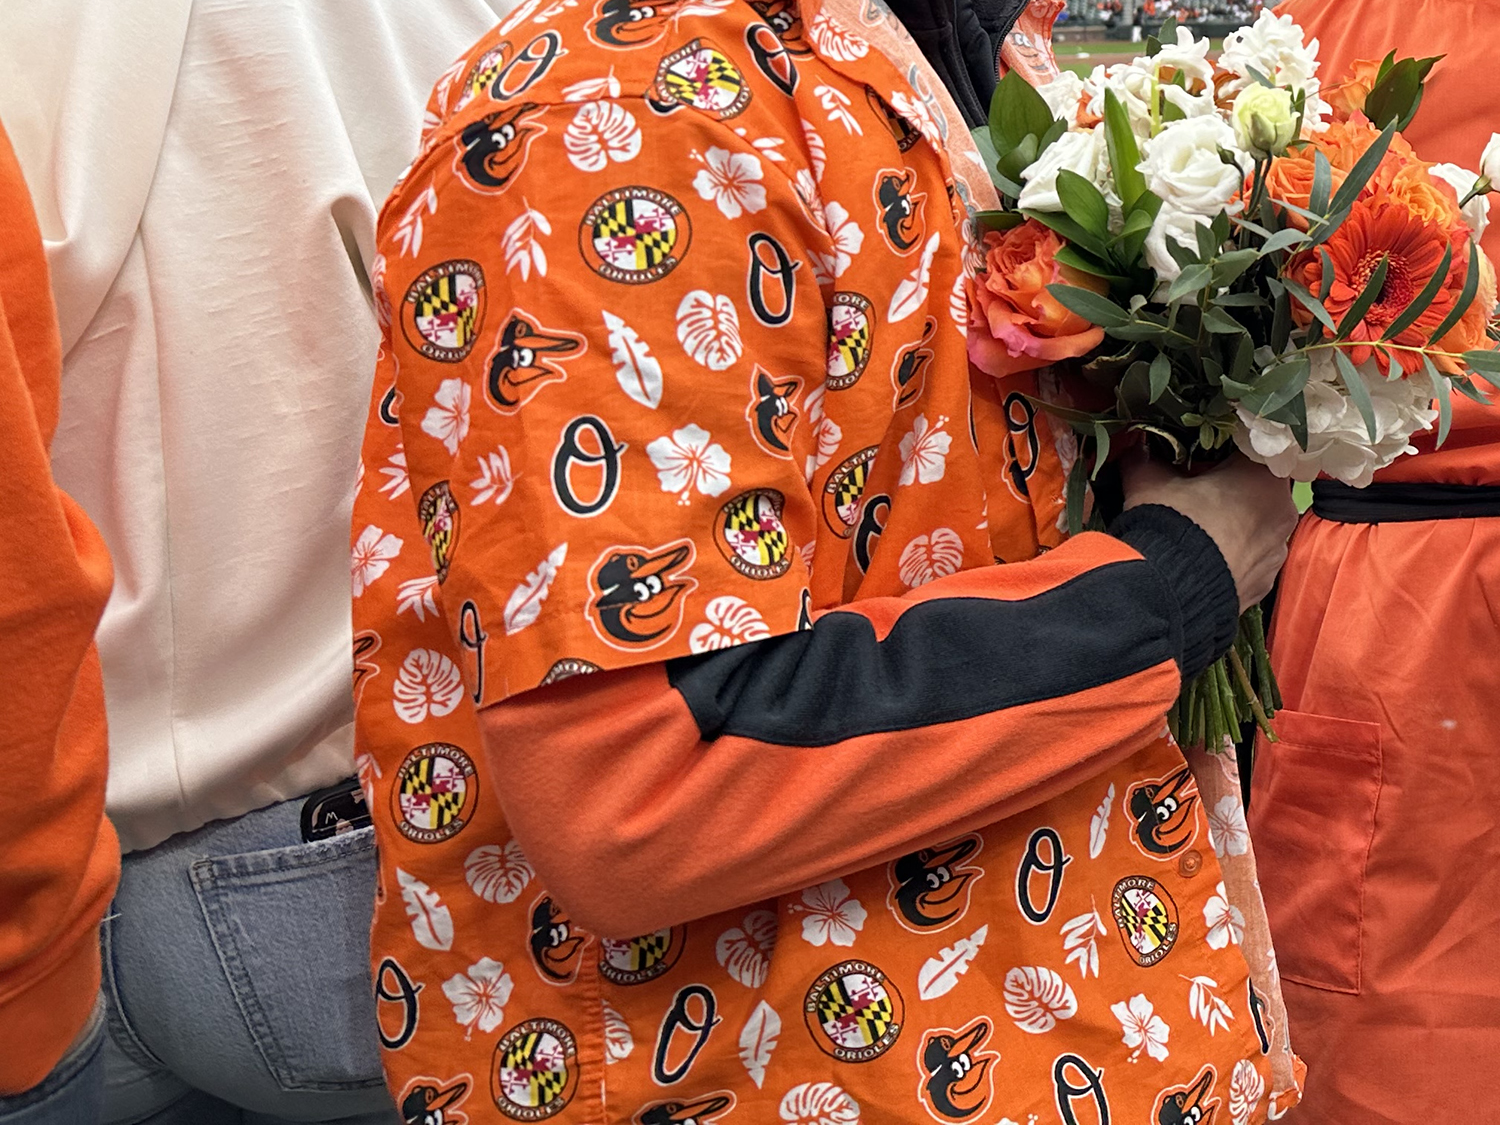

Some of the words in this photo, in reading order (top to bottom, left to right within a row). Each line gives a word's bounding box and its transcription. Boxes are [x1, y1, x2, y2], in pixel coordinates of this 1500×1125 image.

[489, 29, 569, 103] O
[585, 187, 683, 226] BALTIMORE
[746, 230, 803, 328] O
[551, 414, 629, 518] O
[399, 818, 465, 842] ORIOLES
[1015, 826, 1074, 925] O
[1138, 922, 1177, 965] ORIOLES
[375, 956, 426, 1051] O
[806, 962, 886, 1013] BALTIMORE
[499, 1020, 575, 1058] BALTIMORE
[651, 983, 724, 1087] O
[834, 1023, 899, 1060] ORIOLES
[498, 1094, 565, 1120] ORIOLES
